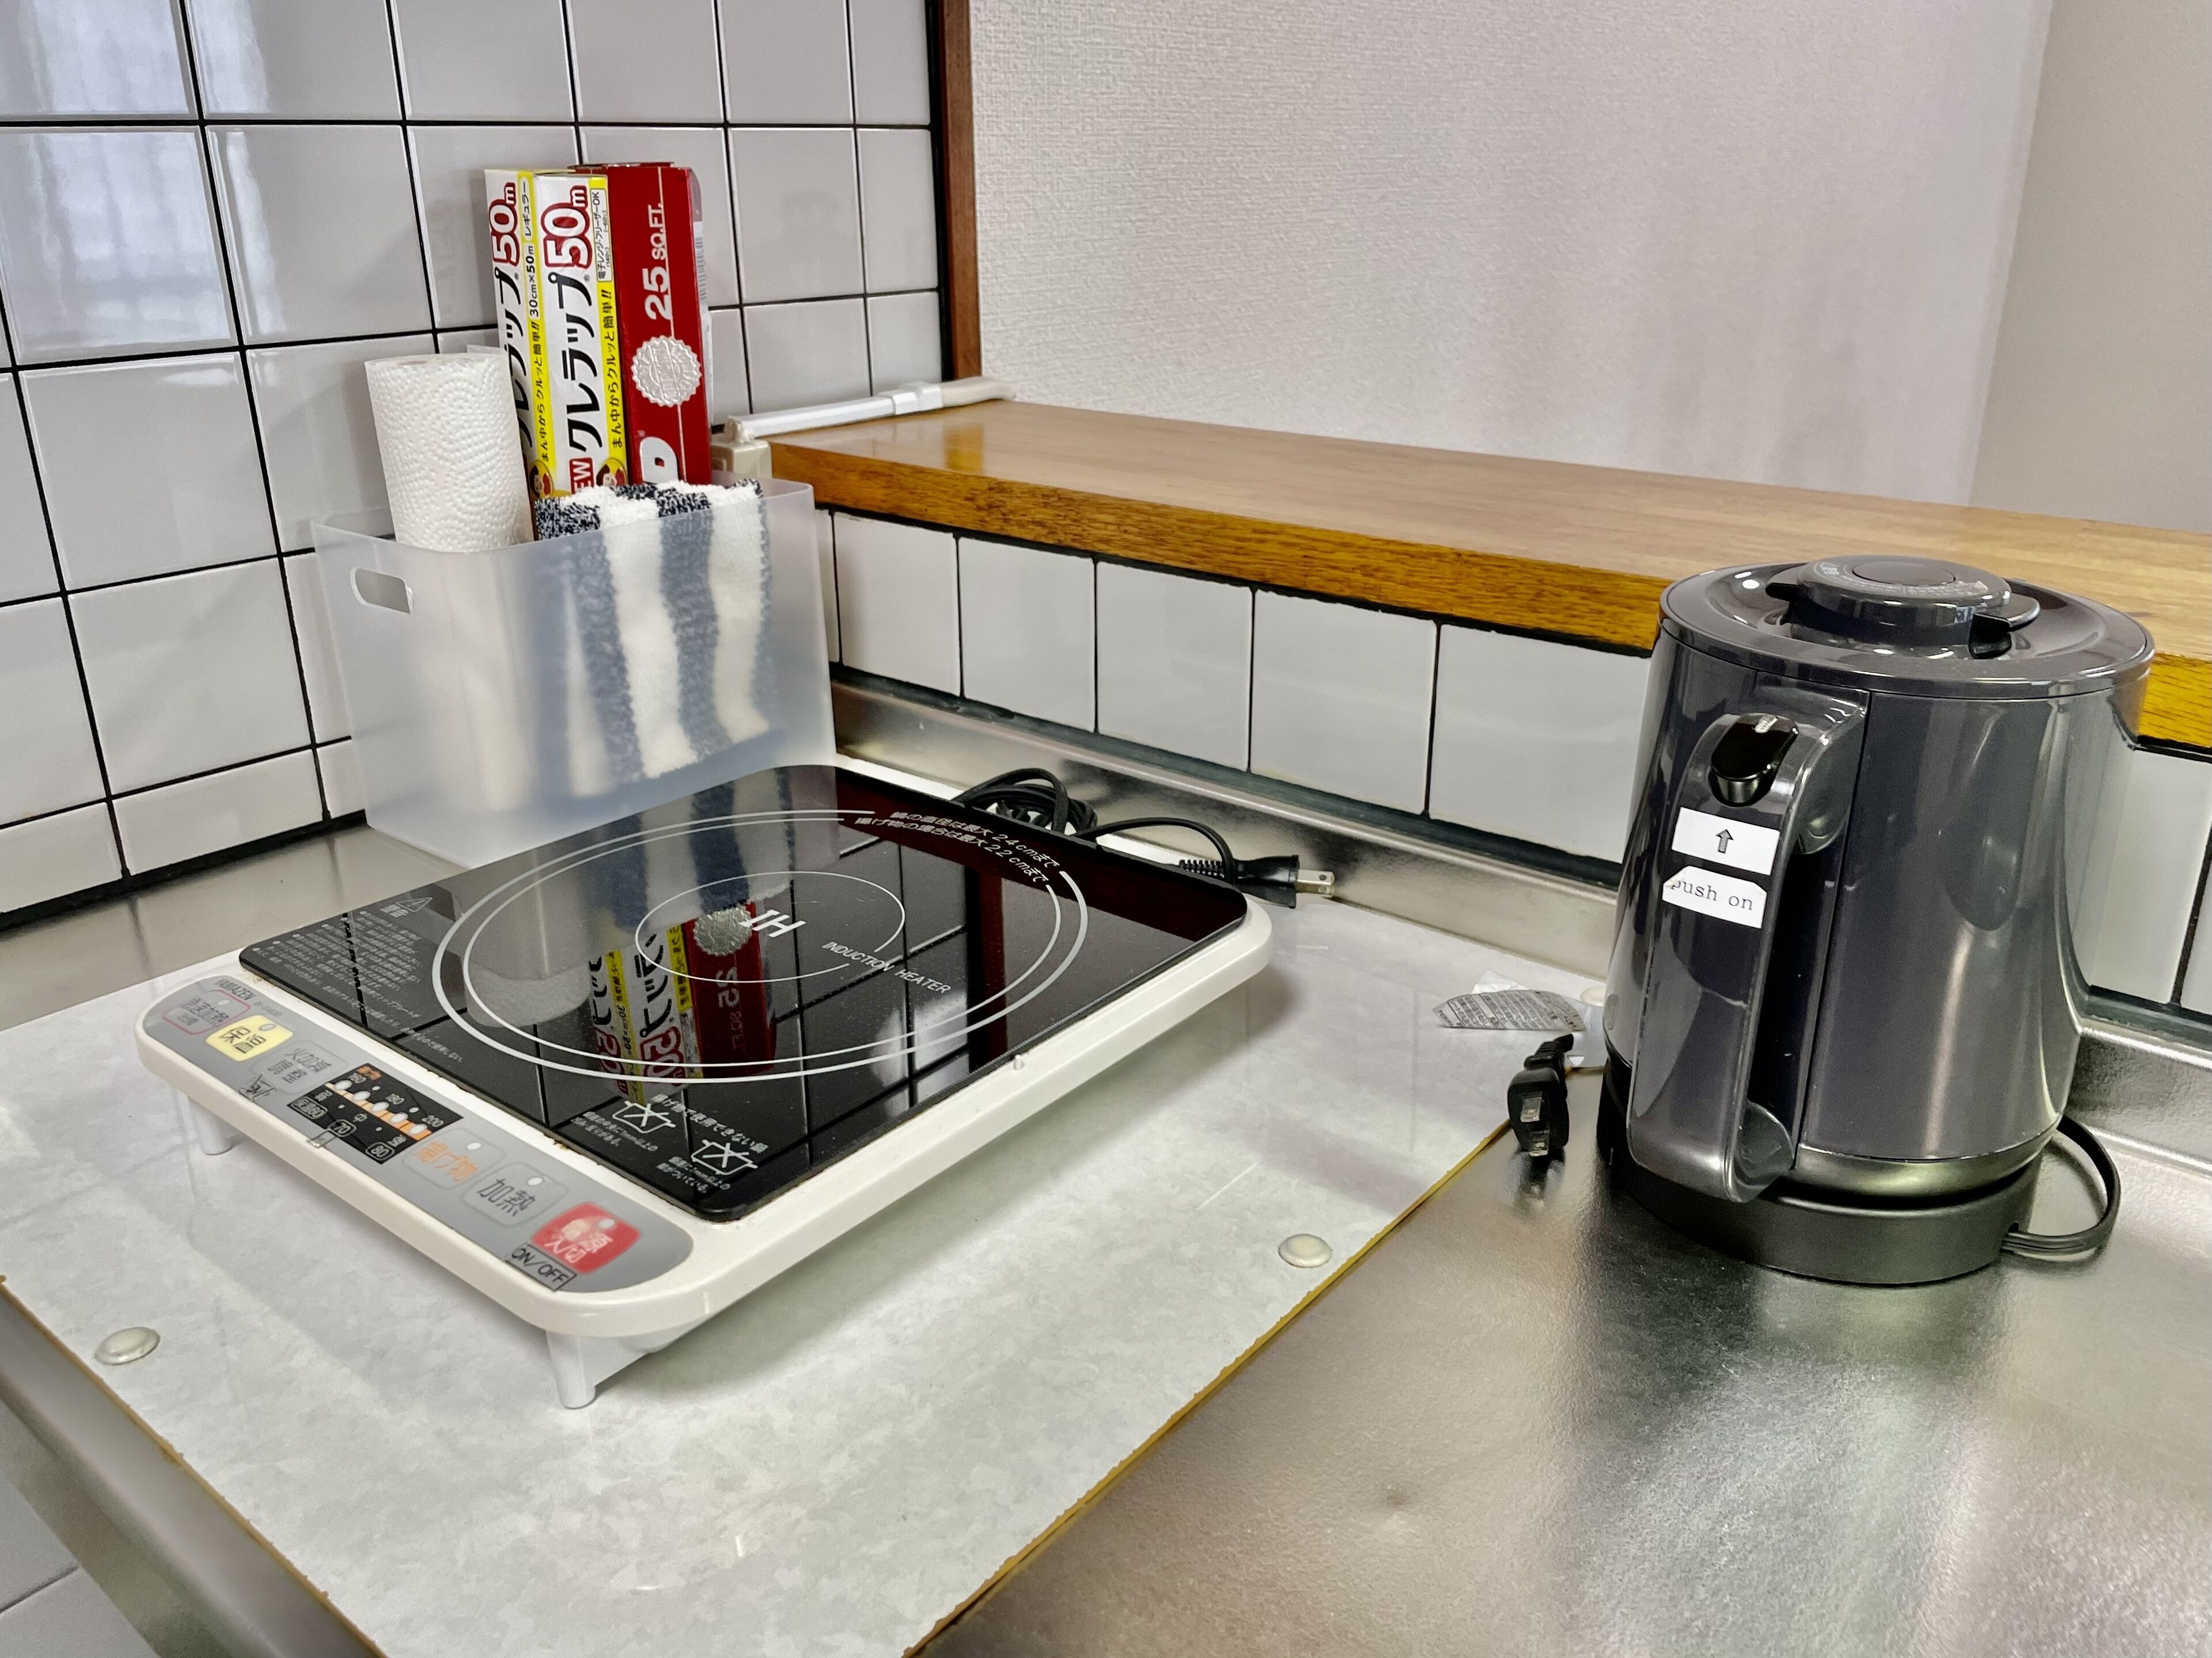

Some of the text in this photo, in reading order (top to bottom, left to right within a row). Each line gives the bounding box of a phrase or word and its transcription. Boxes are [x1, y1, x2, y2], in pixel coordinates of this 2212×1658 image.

[524, 181, 532, 237] レギュラー
[644, 267, 672, 321] 25
[548, 271, 603, 452] クレラップ
[572, 460, 592, 490] EW
[1729, 896, 1753, 911] on
[822, 941, 951, 993] INDUCTION HEATER
[218, 1026, 267, 1054] 保温
[334, 1122, 351, 1134] 70
[352, 1112, 368, 1123] 中
[422, 1115, 444, 1128] 200
[476, 1178, 536, 1217] 加熱
